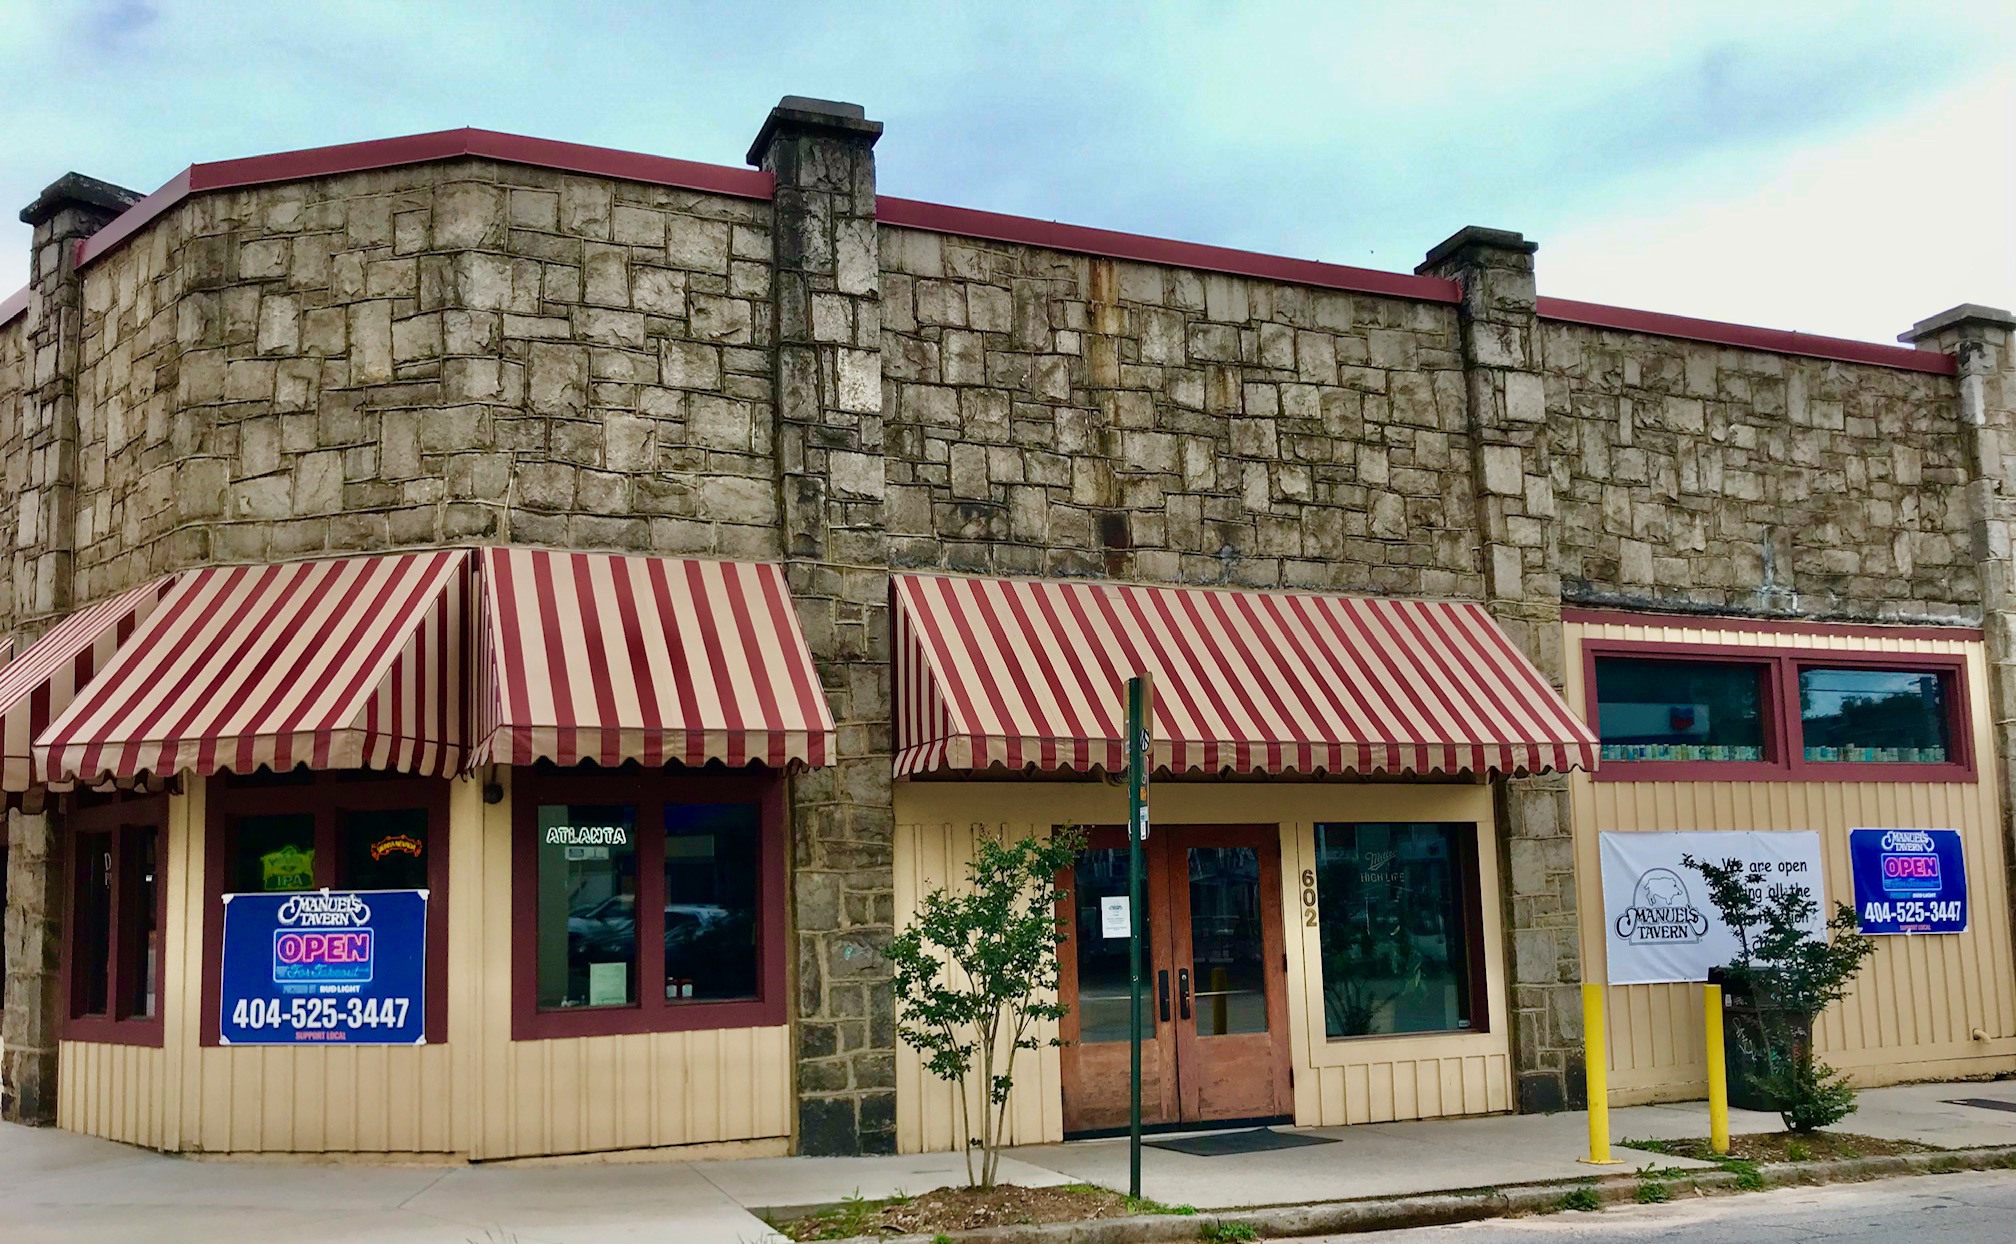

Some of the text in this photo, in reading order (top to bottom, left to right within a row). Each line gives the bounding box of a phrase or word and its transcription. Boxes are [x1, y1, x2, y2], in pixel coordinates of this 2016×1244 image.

[546, 827, 627, 844] ATLANTA
[1881, 831, 1935, 852] MANUEL'S
[1896, 843, 1923, 852] TAVERN
[1365, 850, 1398, 871] Miller
[1722, 858, 1807, 876] We are open
[1884, 857, 1938, 877] OPEN
[277, 875, 303, 886] IPA
[1360, 873, 1405, 882] HIGH LIFE
[1302, 869, 1317, 927] 602
[1788, 883, 1811, 898] the
[278, 895, 371, 926] MANUEL'S
[300, 911, 350, 926] TAVERN
[1864, 901, 1961, 923] 404-525-3447
[1616, 904, 1709, 938] MANUEL'S
[1637, 925, 1688, 939] TAVERN
[277, 934, 370, 963] OPEN
[320, 985, 337, 994] BUD
[337, 985, 361, 994] LIGHT
[233, 998, 410, 1029] 404-525-3447
[326, 1031, 346, 1041] LOCAL
